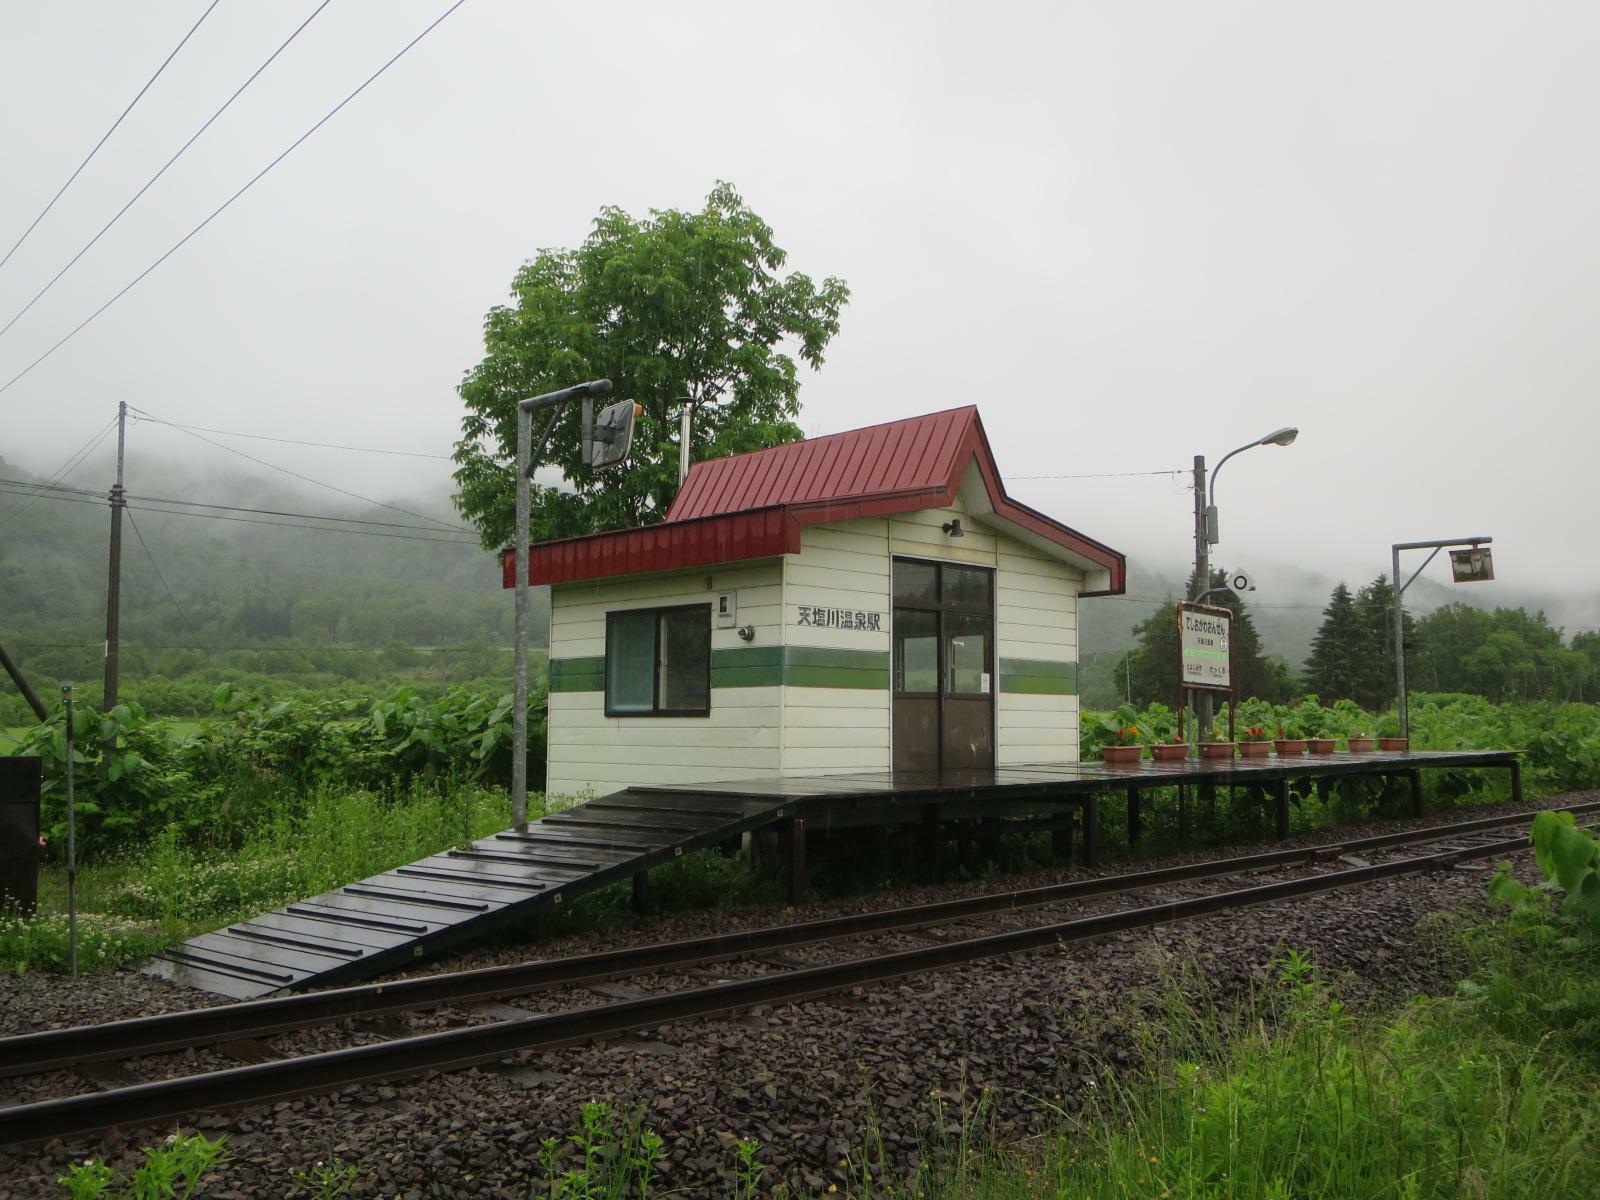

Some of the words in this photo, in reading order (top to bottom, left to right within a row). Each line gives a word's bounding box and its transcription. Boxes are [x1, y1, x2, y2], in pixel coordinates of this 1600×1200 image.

[798, 607, 880, 631] 天塩川温泉駅
[1186, 617, 1225, 635] てしおがわおんせん
